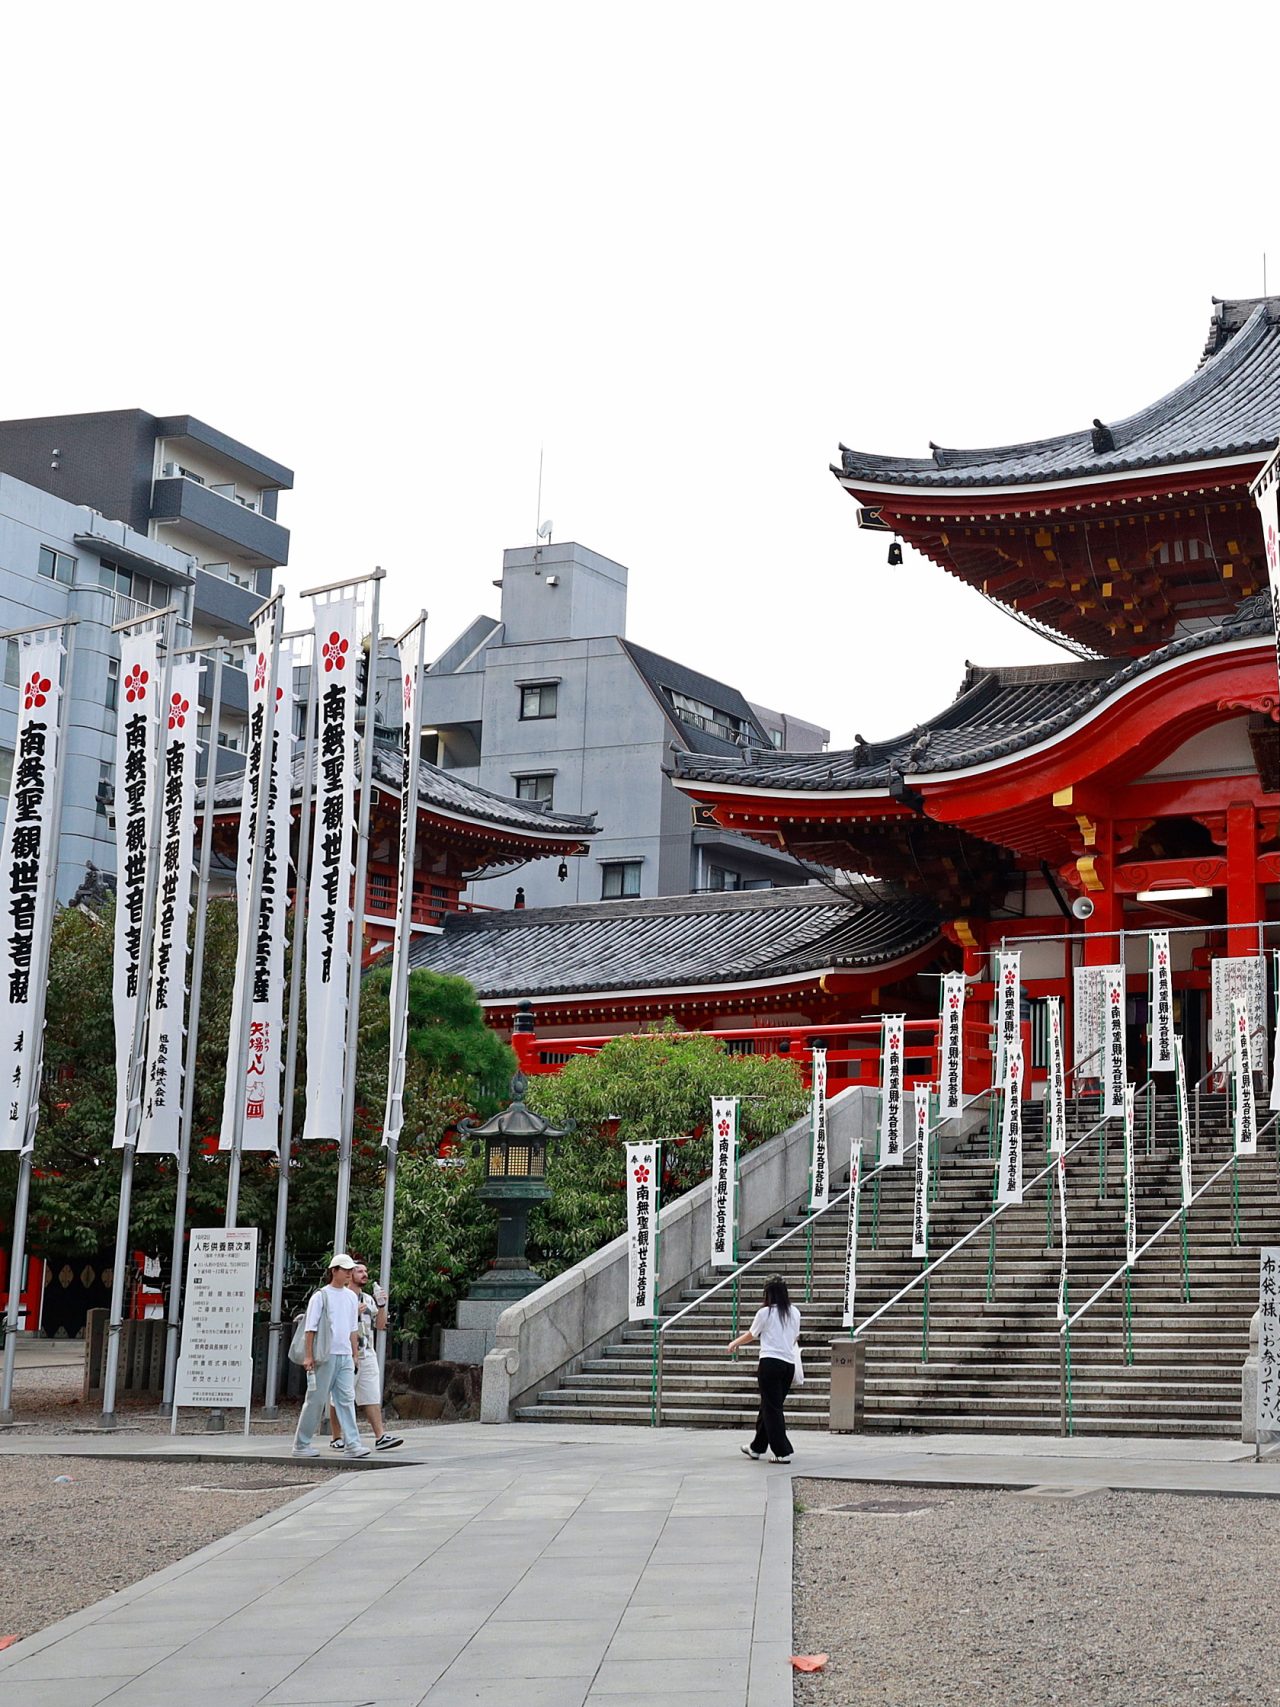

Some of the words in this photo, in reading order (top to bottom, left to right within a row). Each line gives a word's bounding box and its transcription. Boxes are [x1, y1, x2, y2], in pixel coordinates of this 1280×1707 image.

[7, 720, 48, 1004] 南無聖観世音菩薩
[246, 1021, 265, 1075] 矢場とん
[630, 1154, 652, 1164] 奉納
[194, 1242, 251, 1251] 人形供養祭次第
[636, 1185, 650, 1308] 南無聖観世音菩薩
[1260, 1254, 1277, 1421] 布袋様にお参り下さい
